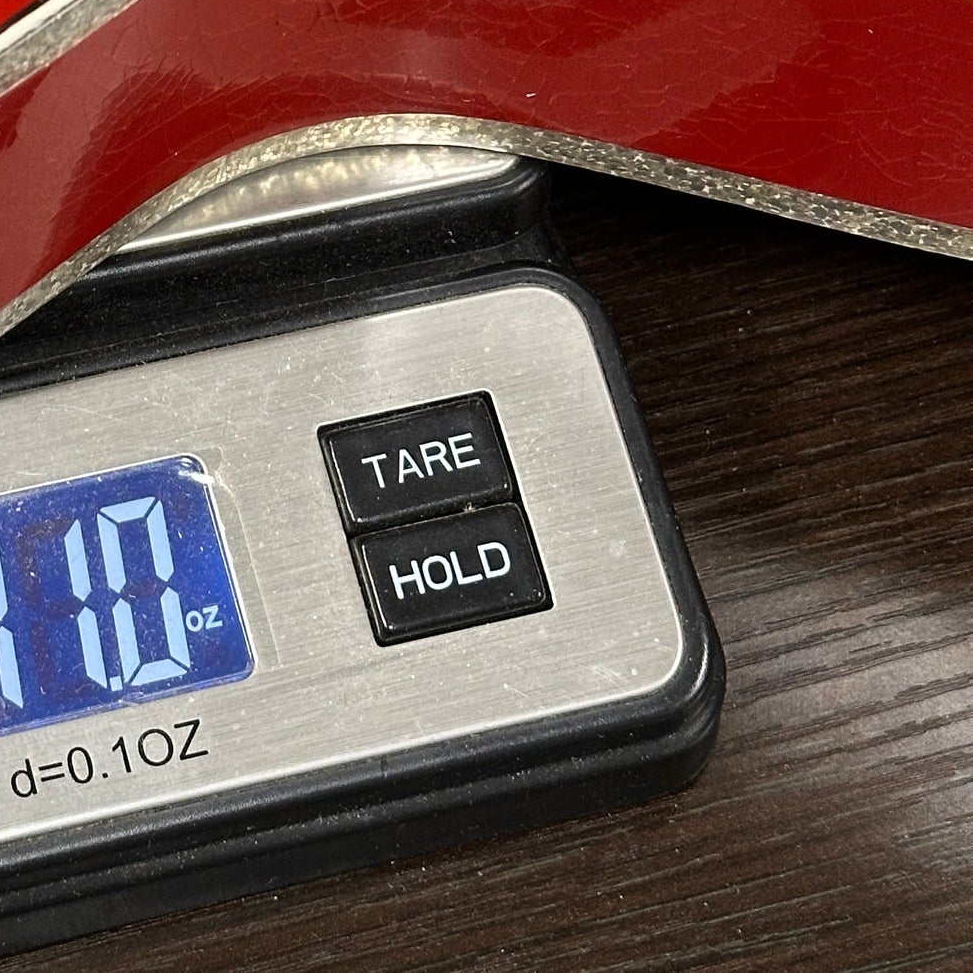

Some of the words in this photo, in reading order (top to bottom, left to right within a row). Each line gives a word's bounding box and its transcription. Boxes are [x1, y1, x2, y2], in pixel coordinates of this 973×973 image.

[361, 432, 481, 489] TARE
[388, 541, 511, 600] HOLD
[11, 719, 209, 798] d=0.1OZ
